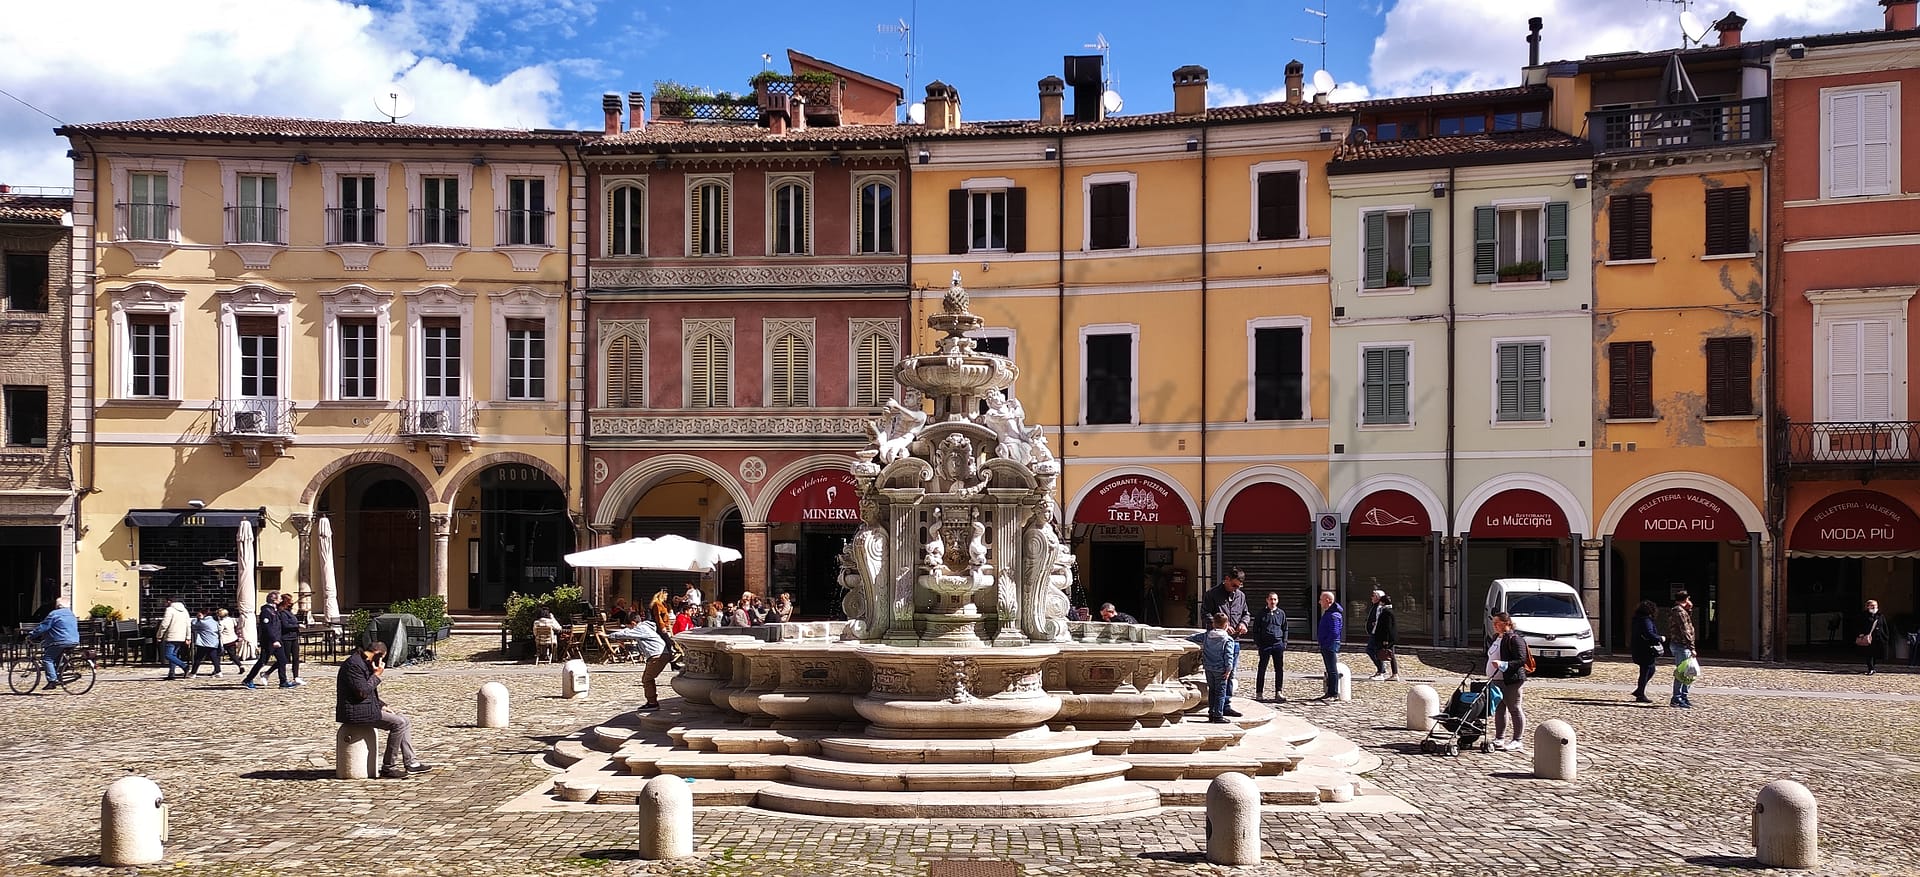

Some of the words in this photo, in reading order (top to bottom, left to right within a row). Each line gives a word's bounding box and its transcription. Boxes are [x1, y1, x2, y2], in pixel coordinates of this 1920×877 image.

[789, 475, 828, 497] Cartoleria
[1098, 478, 1138, 496] RISTORANTE
[1143, 479, 1169, 497] PIZZERIA
[1638, 493, 1682, 514] PELLETTERIA
[1686, 494, 1721, 514] VALIGERIA
[802, 508, 858, 520] MINERVA
[1107, 509, 1131, 521] TRE
[1133, 510, 1160, 523] PAPI
[1814, 502, 1860, 522] PELLETTERIA
[1865, 502, 1902, 523] VALIGERIA
[1486, 515, 1499, 526] La
[1502, 515, 1552, 528] Muccigna
[1644, 518, 1688, 530] MODA
[1119, 524, 1140, 534] PAPI
[1821, 528, 1866, 540] MODA
